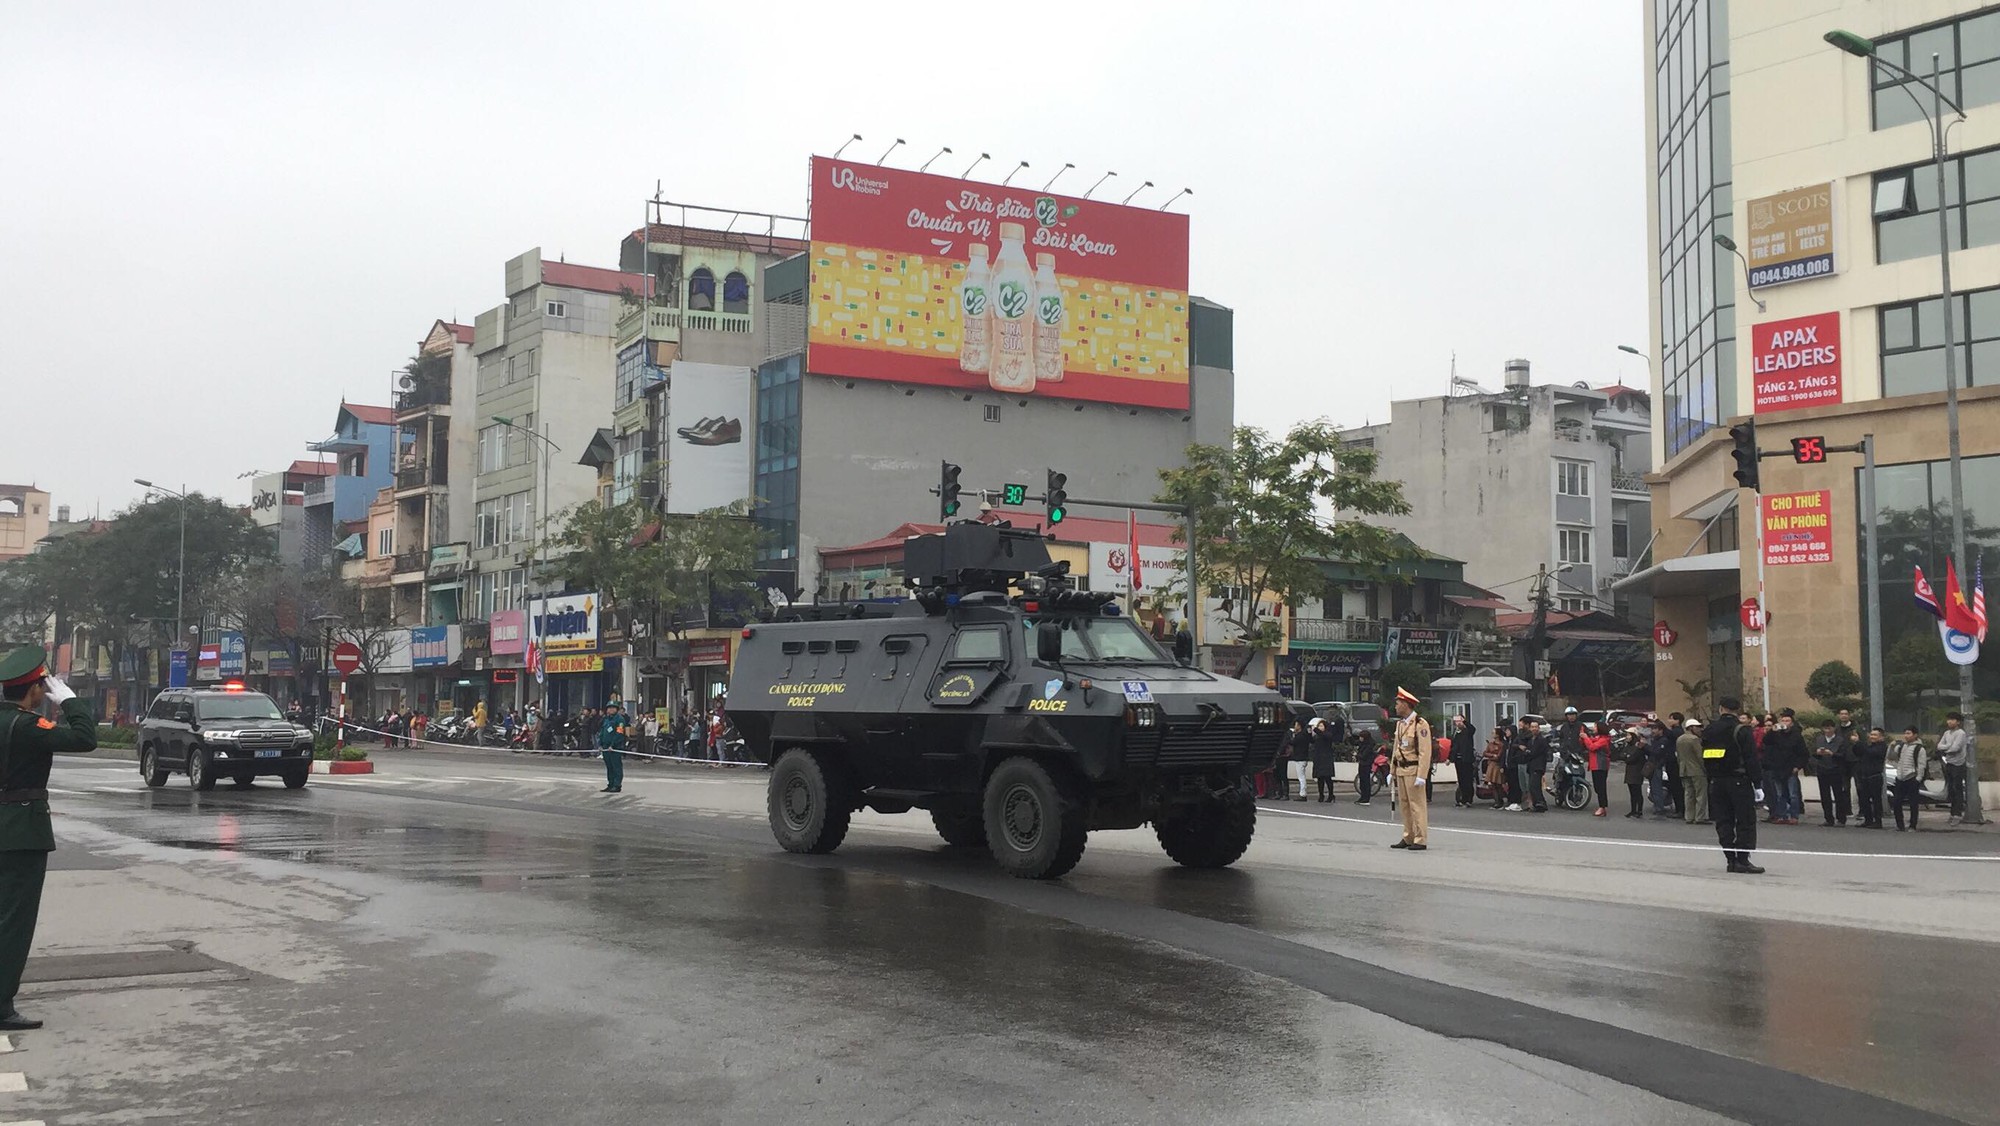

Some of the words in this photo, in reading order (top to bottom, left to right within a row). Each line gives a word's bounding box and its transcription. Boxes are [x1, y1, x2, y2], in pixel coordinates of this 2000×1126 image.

[855, 177, 889, 189] Universal
[855, 184, 881, 195] Robina
[960, 190, 994, 214] Trà
[997, 198, 1033, 219] Sữa
[1035, 200, 1058, 225] C2
[1778, 191, 1829, 216] SCOTS
[907, 208, 966, 234] Chuẩn
[967, 218, 992, 242] Vị
[1032, 227, 1068, 249] Đài
[1069, 233, 1118, 257] Loan
[1800, 234, 1825, 250] IELTS
[1752, 258, 1830, 286] 0944.948.008
[964, 288, 987, 315] C2
[1000, 284, 1028, 318] C2
[1040, 299, 1061, 325] C2
[1771, 326, 1818, 350] APAX
[1754, 345, 1836, 374] LEADERS
[1830, 375, 1837, 385] 3
[1799, 438, 1823, 462] 35
[1005, 485, 1023, 504] 30
[1771, 496, 1793, 510] CHO
[1795, 492, 1822, 508] THUÊ
[1766, 514, 1788, 530] VĂN
[1790, 512, 1827, 528] PHÒNG
[1767, 555, 1789, 564] 0243
[1808, 552, 1830, 562] 4325
[768, 683, 792, 695] CẢNH
[791, 682, 809, 694] SÁT
[787, 696, 816, 707] POLICE
[1027, 699, 1068, 712] POLICE
